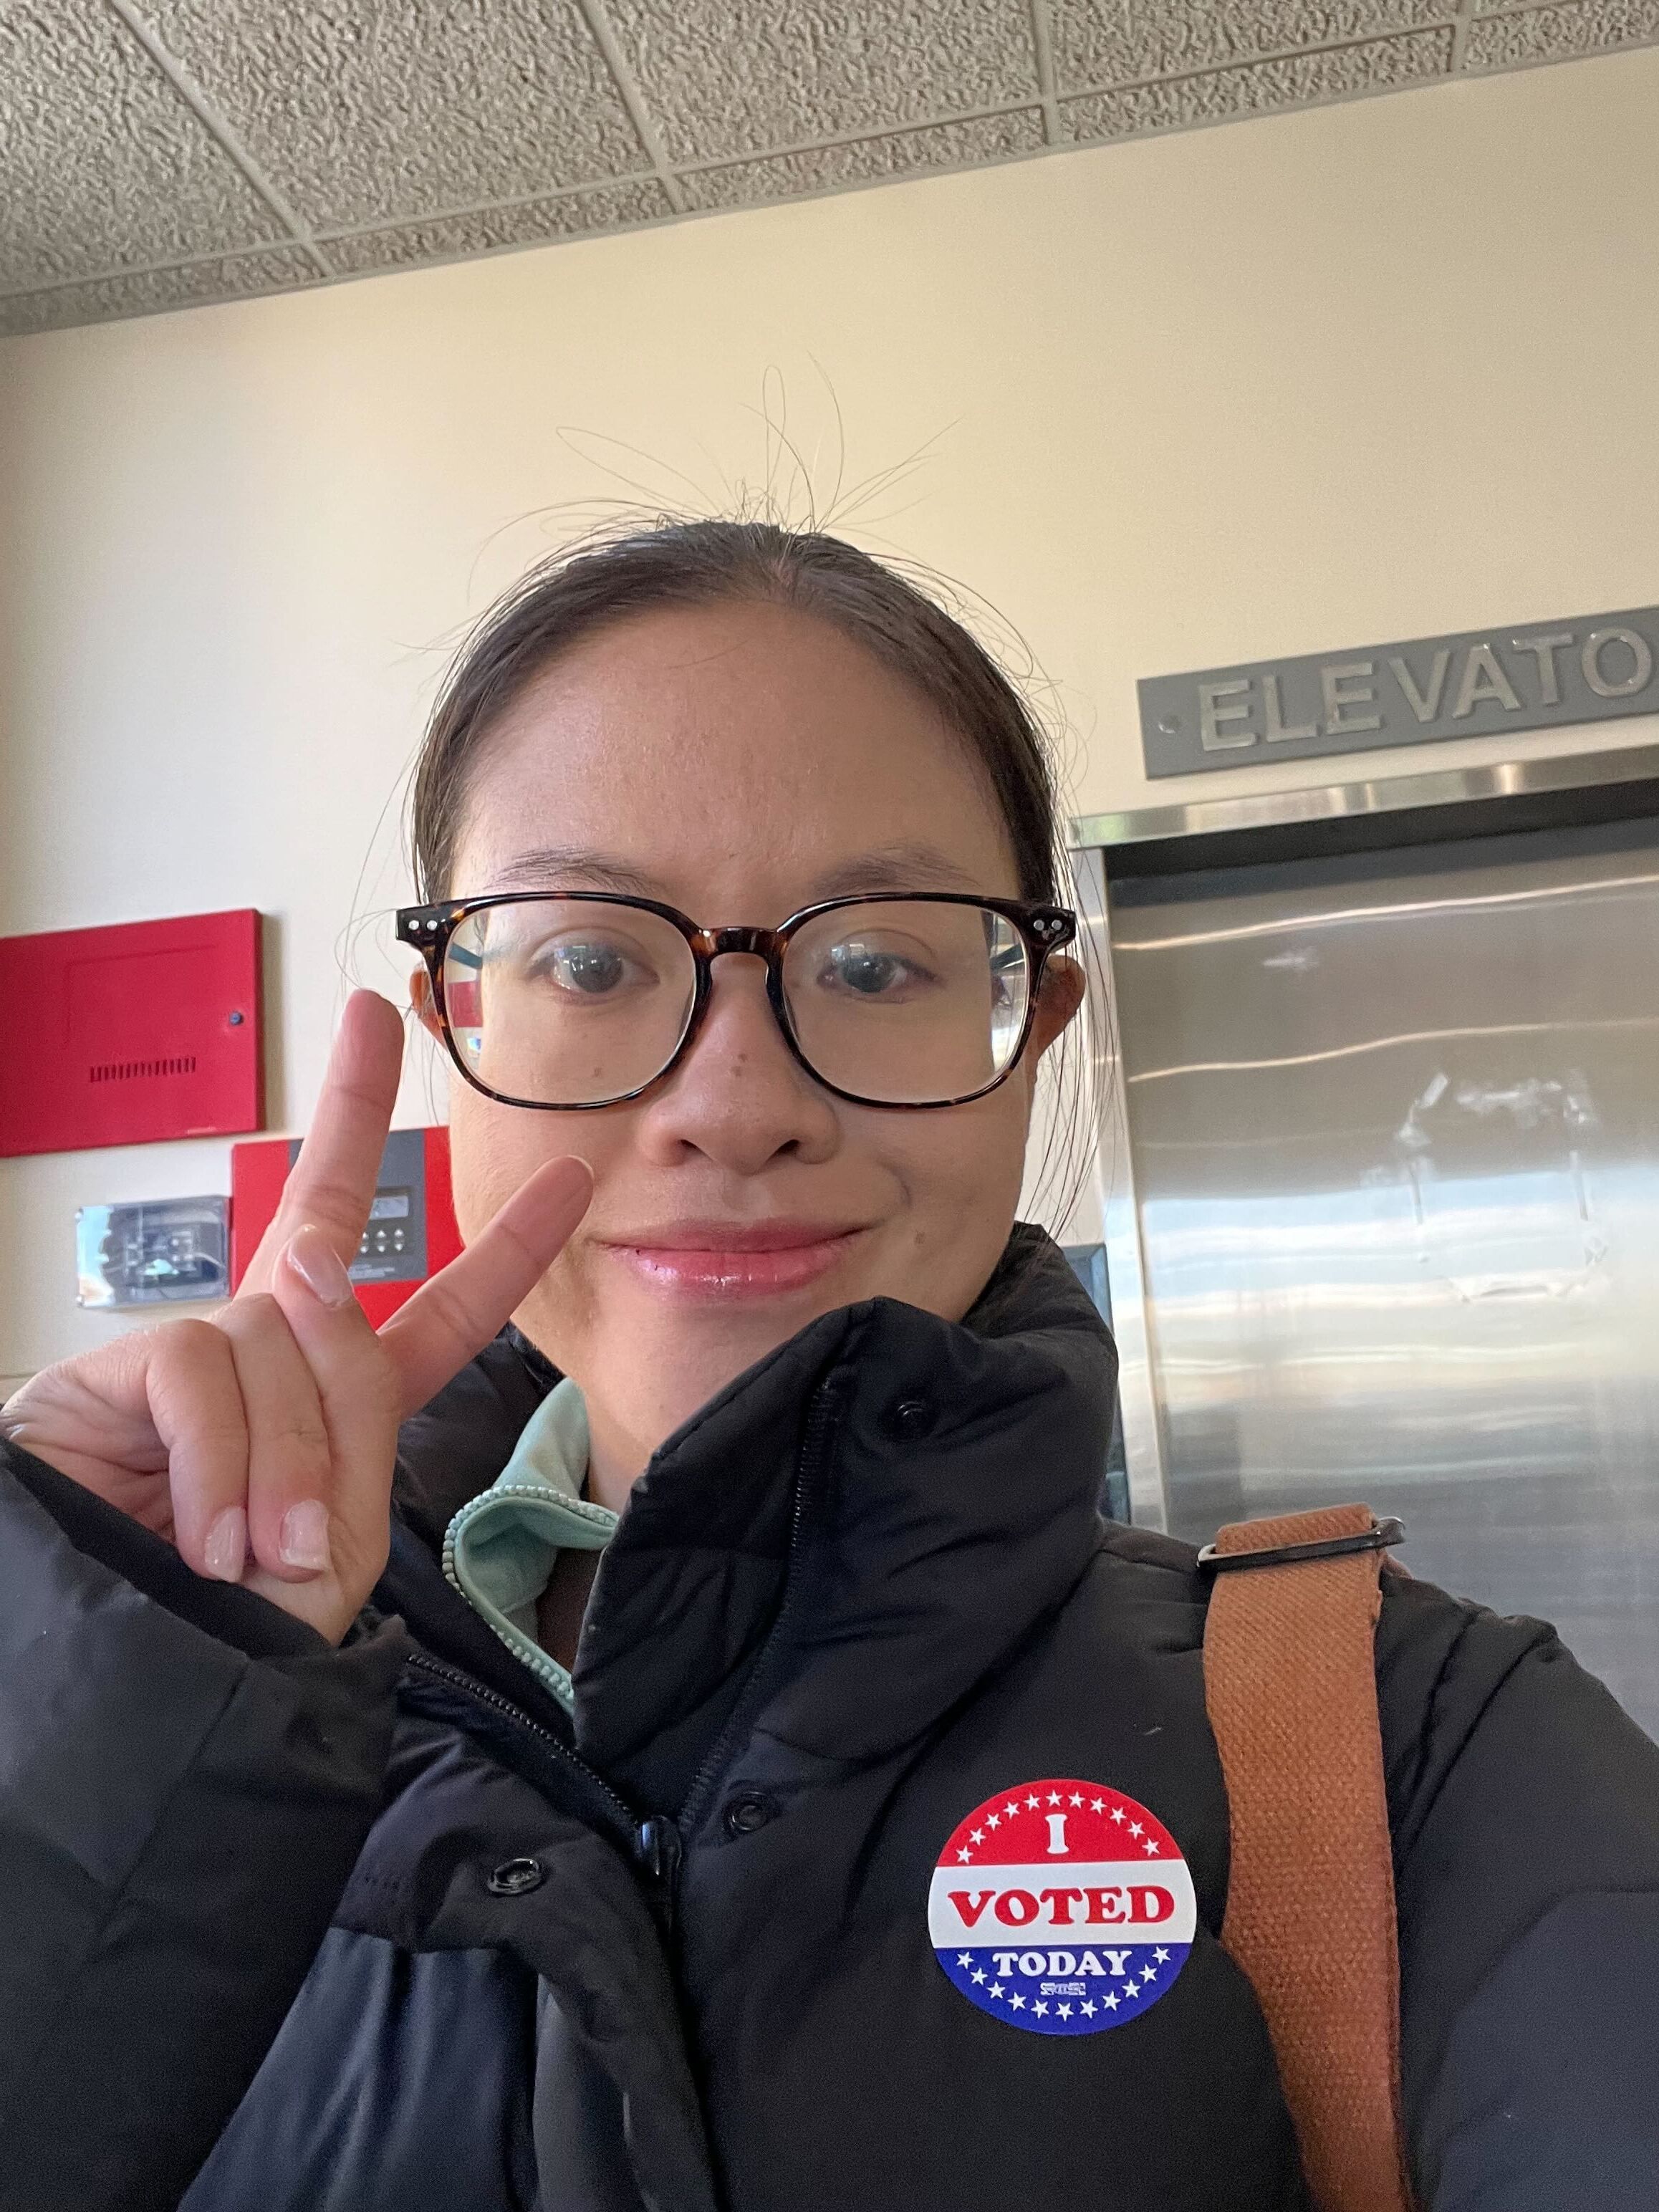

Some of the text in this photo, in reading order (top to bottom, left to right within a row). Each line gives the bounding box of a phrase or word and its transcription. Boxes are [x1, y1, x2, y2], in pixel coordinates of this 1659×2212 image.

[1198, 627, 1652, 751] ELEVATO
[1045, 1813, 1069, 1854] I
[948, 1886, 1175, 1927] VOTED
[993, 1951, 1132, 1976] TODAY
